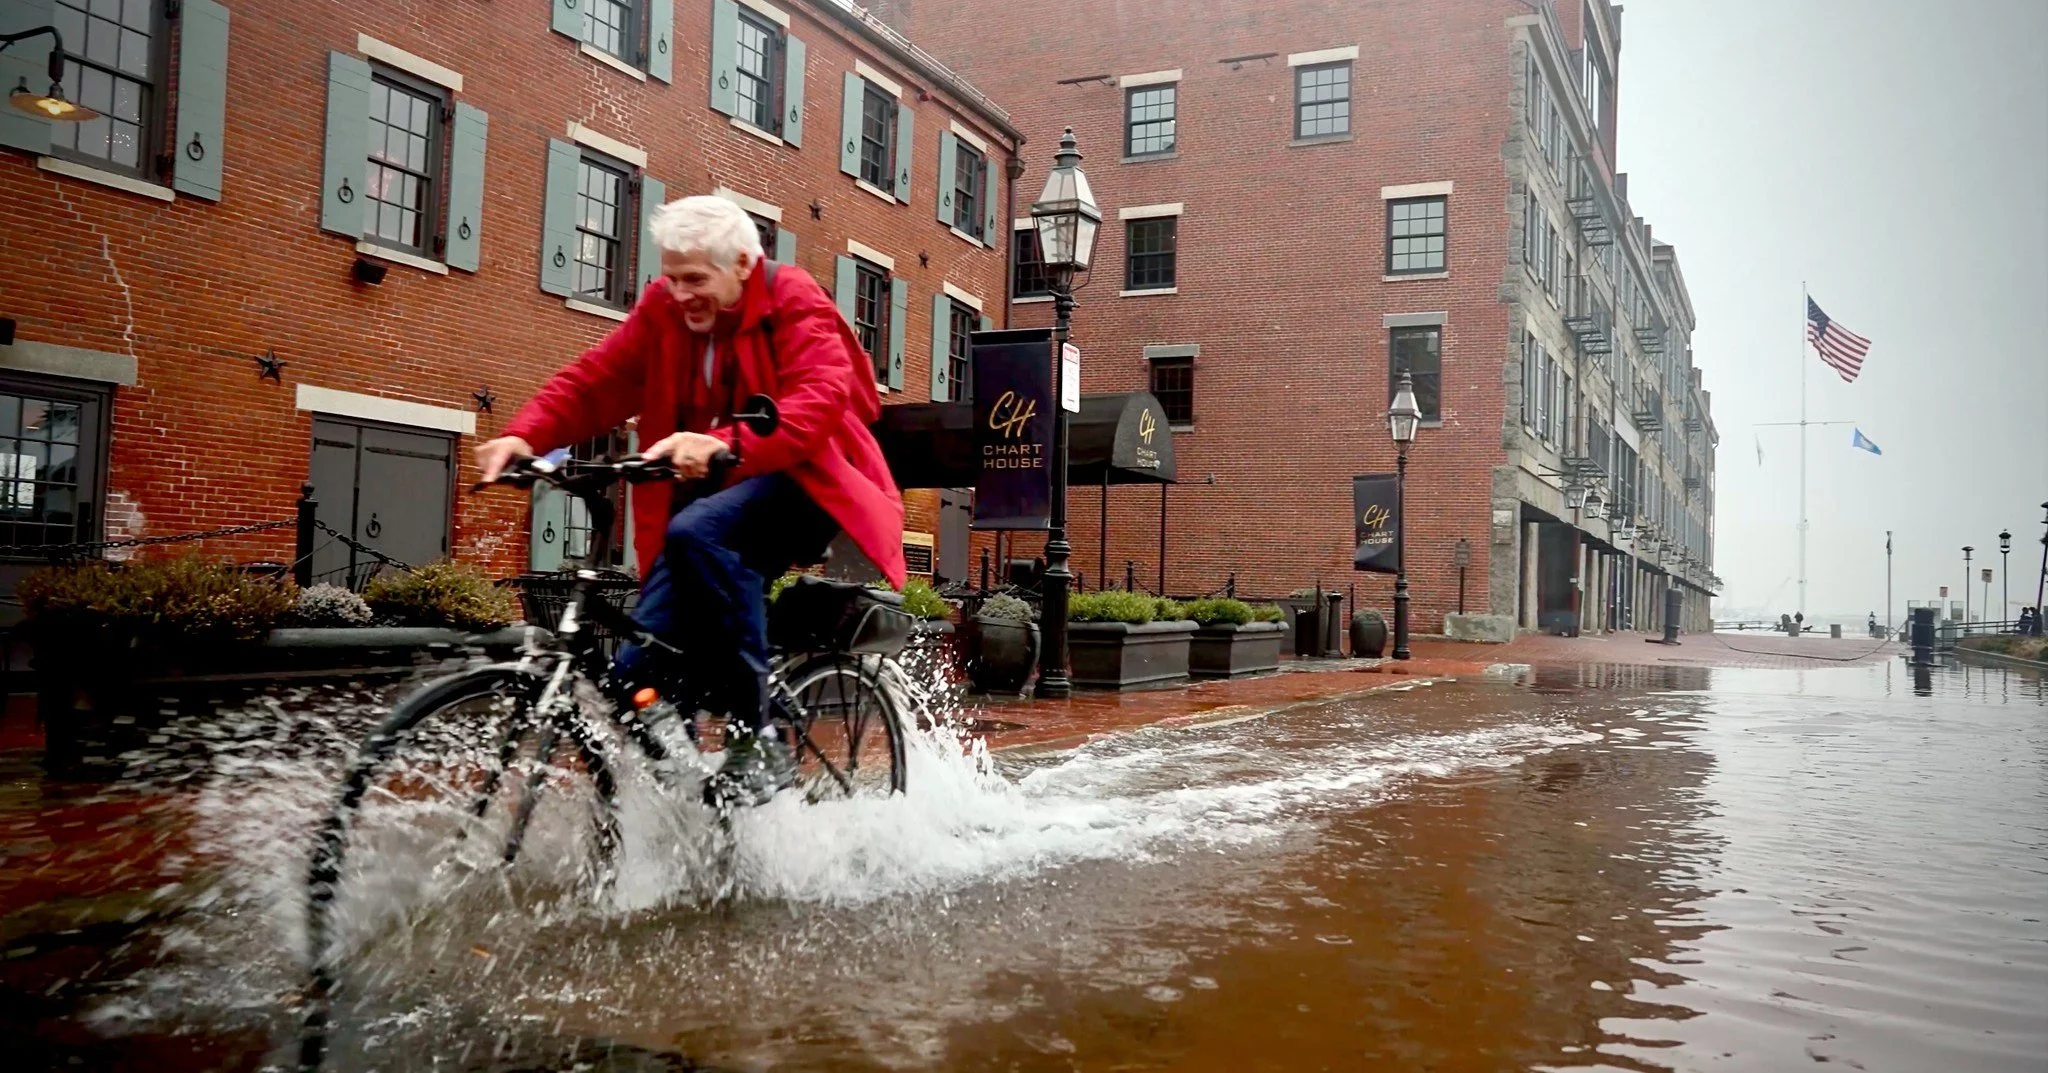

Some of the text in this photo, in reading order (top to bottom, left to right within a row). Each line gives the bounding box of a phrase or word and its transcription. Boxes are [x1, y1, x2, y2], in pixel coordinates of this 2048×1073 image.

[989, 391, 1036, 438] CH
[983, 444, 1043, 455] CHART
[983, 457, 1043, 469] HOUSE
[1360, 530, 1394, 538] CHART
[1360, 537, 1394, 545] HOUSE
